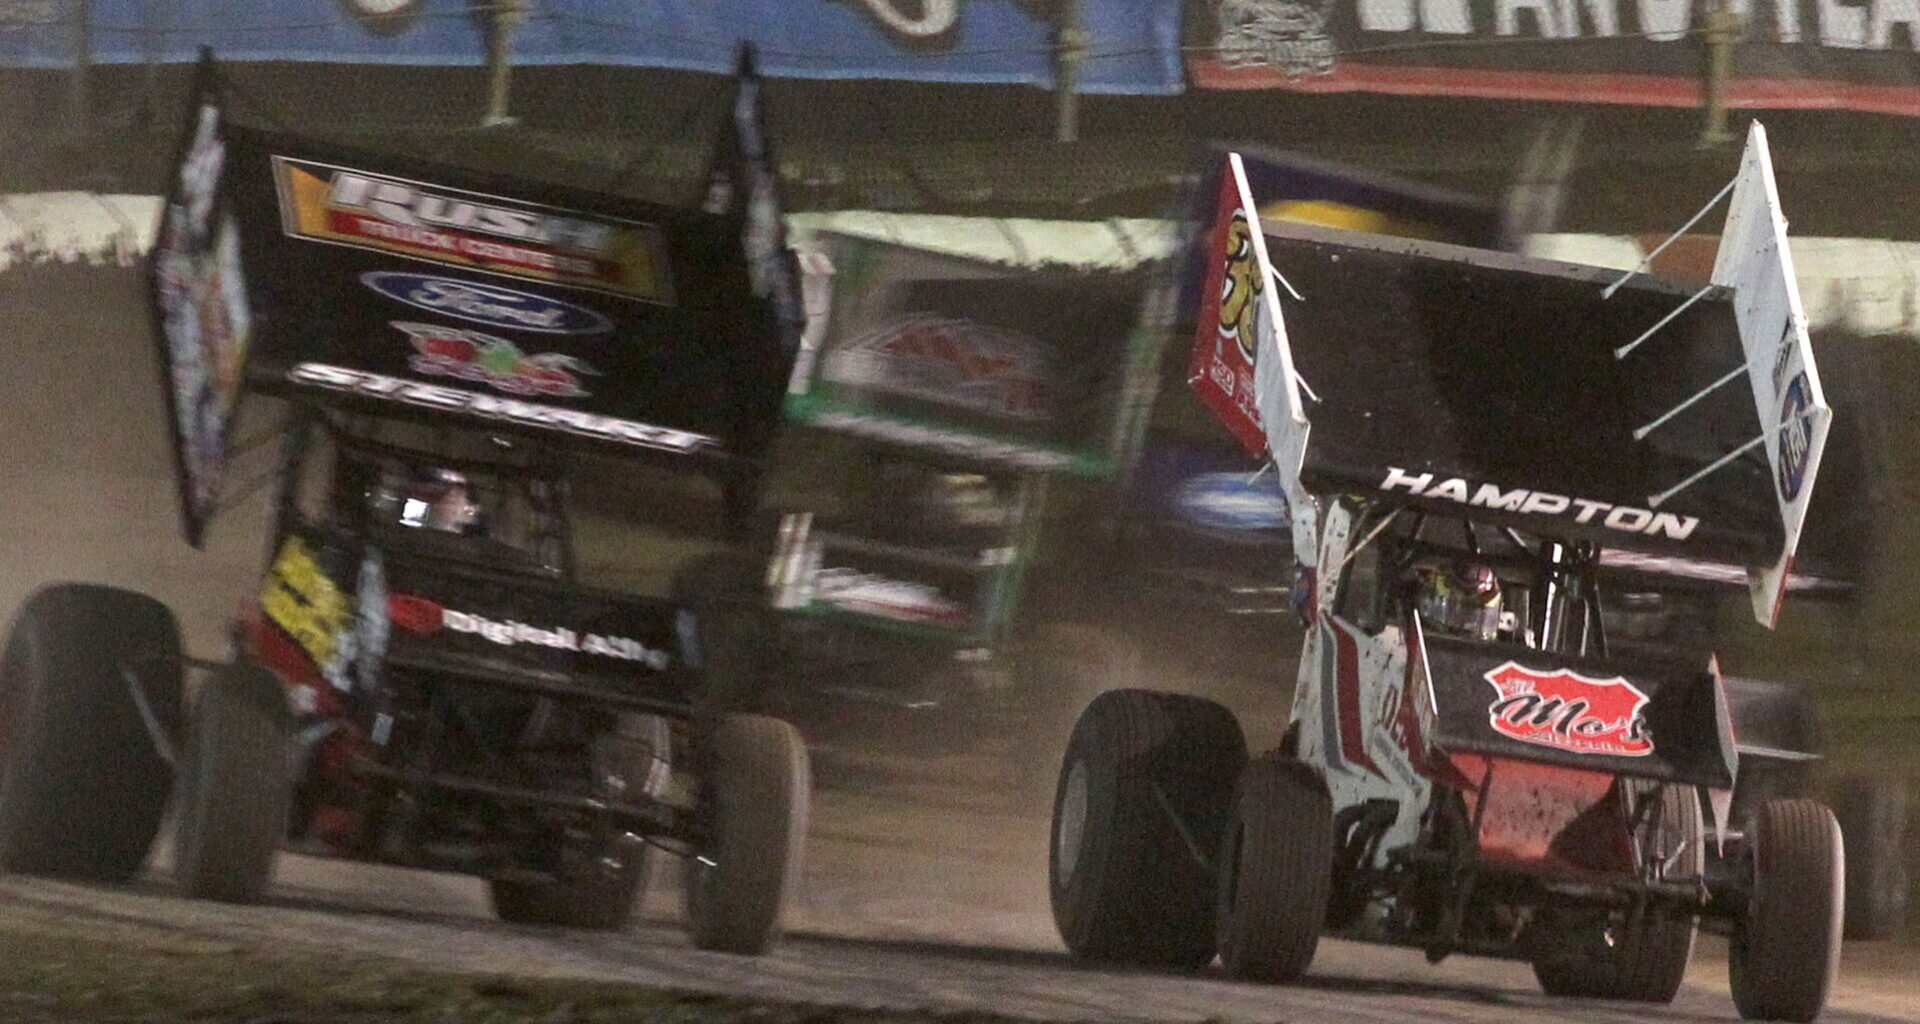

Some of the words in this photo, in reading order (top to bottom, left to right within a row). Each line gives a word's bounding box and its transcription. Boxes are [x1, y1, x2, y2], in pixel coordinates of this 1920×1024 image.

[289, 362, 712, 454] STEWART
[1379, 467, 1698, 540] HAMPTON
[1489, 693, 1652, 743] Mo's
